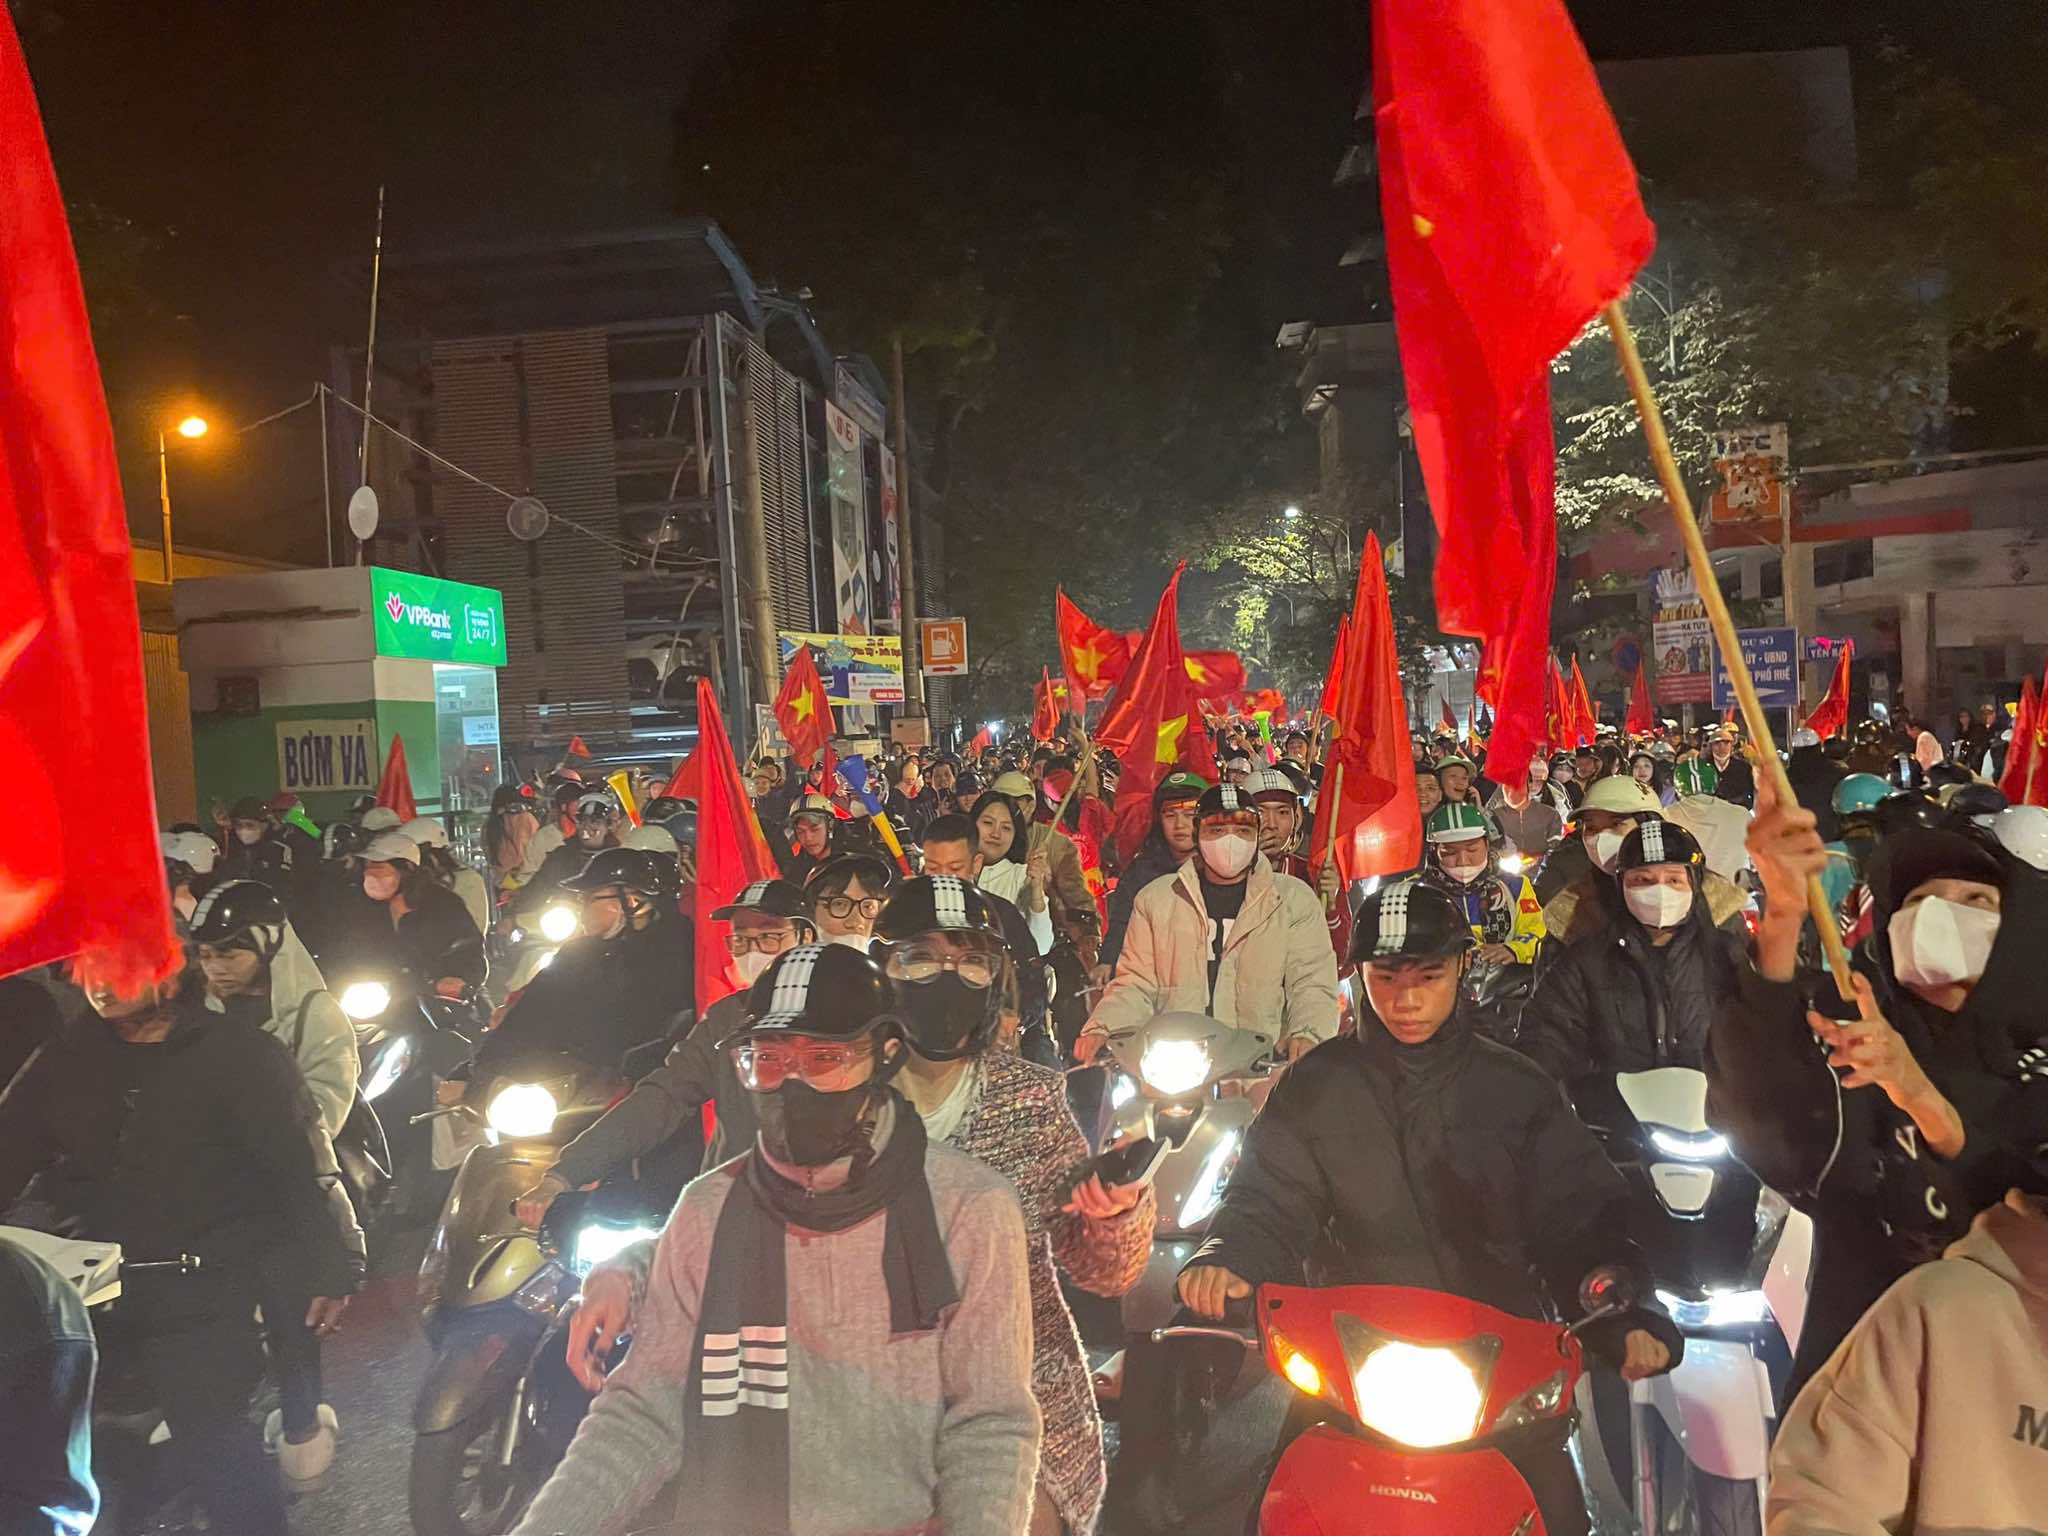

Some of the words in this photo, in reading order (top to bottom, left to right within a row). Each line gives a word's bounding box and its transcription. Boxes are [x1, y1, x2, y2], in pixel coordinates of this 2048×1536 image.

[405, 604, 452, 631] VPBank
[1764, 650, 1788, 664] UBND
[1754, 665, 1772, 682] PHỐ
[1774, 664, 1791, 681] HUẾ
[285, 729, 333, 787] BƠM
[341, 723, 369, 786] VÁ
[1369, 1484, 1437, 1504] HONDA
